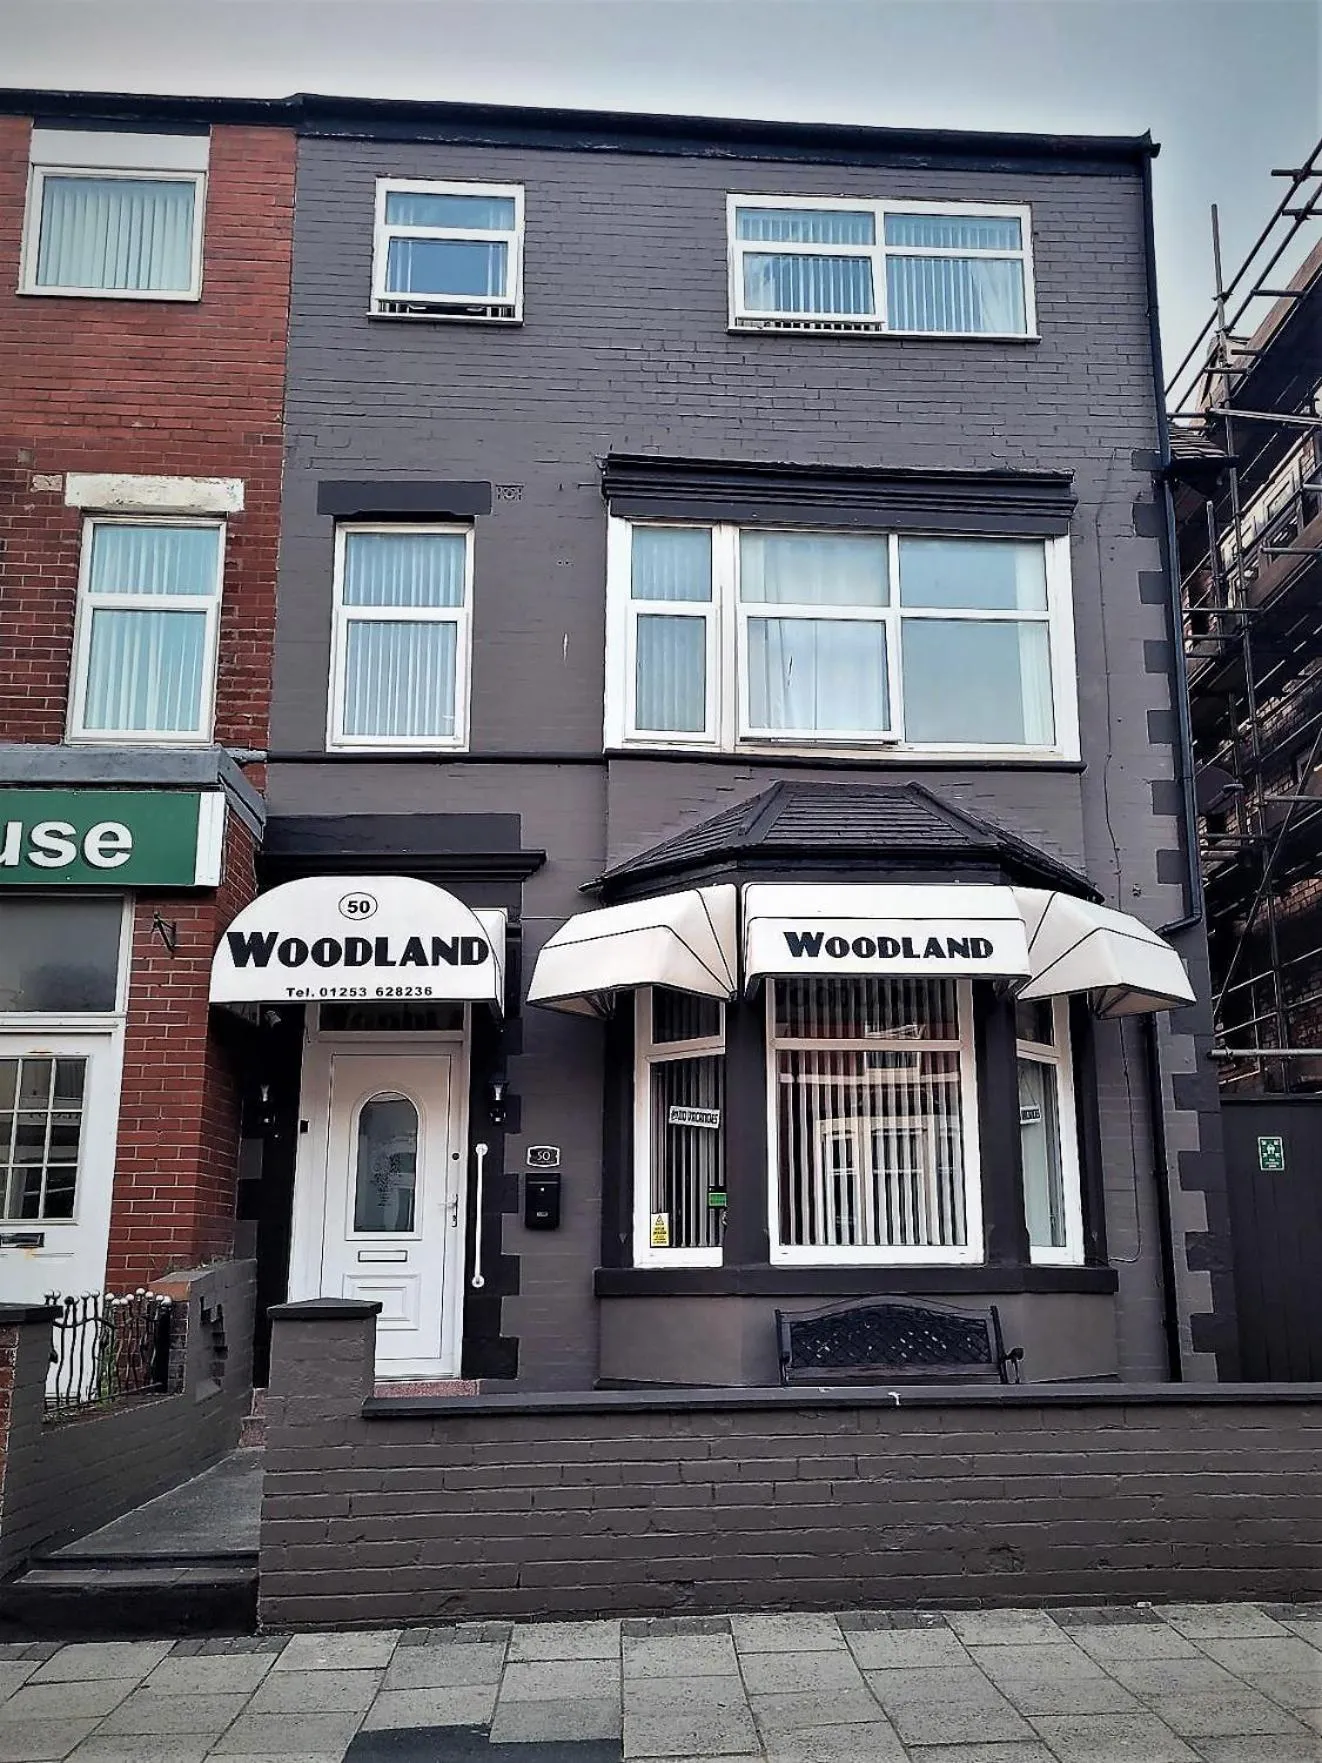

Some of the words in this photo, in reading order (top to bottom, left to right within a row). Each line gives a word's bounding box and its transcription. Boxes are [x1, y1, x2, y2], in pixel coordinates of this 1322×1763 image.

[347, 899, 371, 914] 50
[226, 931, 490, 968] WOODLAND
[783, 931, 994, 959] WOODLAND
[286, 987, 315, 998] Tel.
[319, 987, 367, 997] 01253
[375, 986, 433, 997] 628236
[537, 1151, 551, 1161] 50
